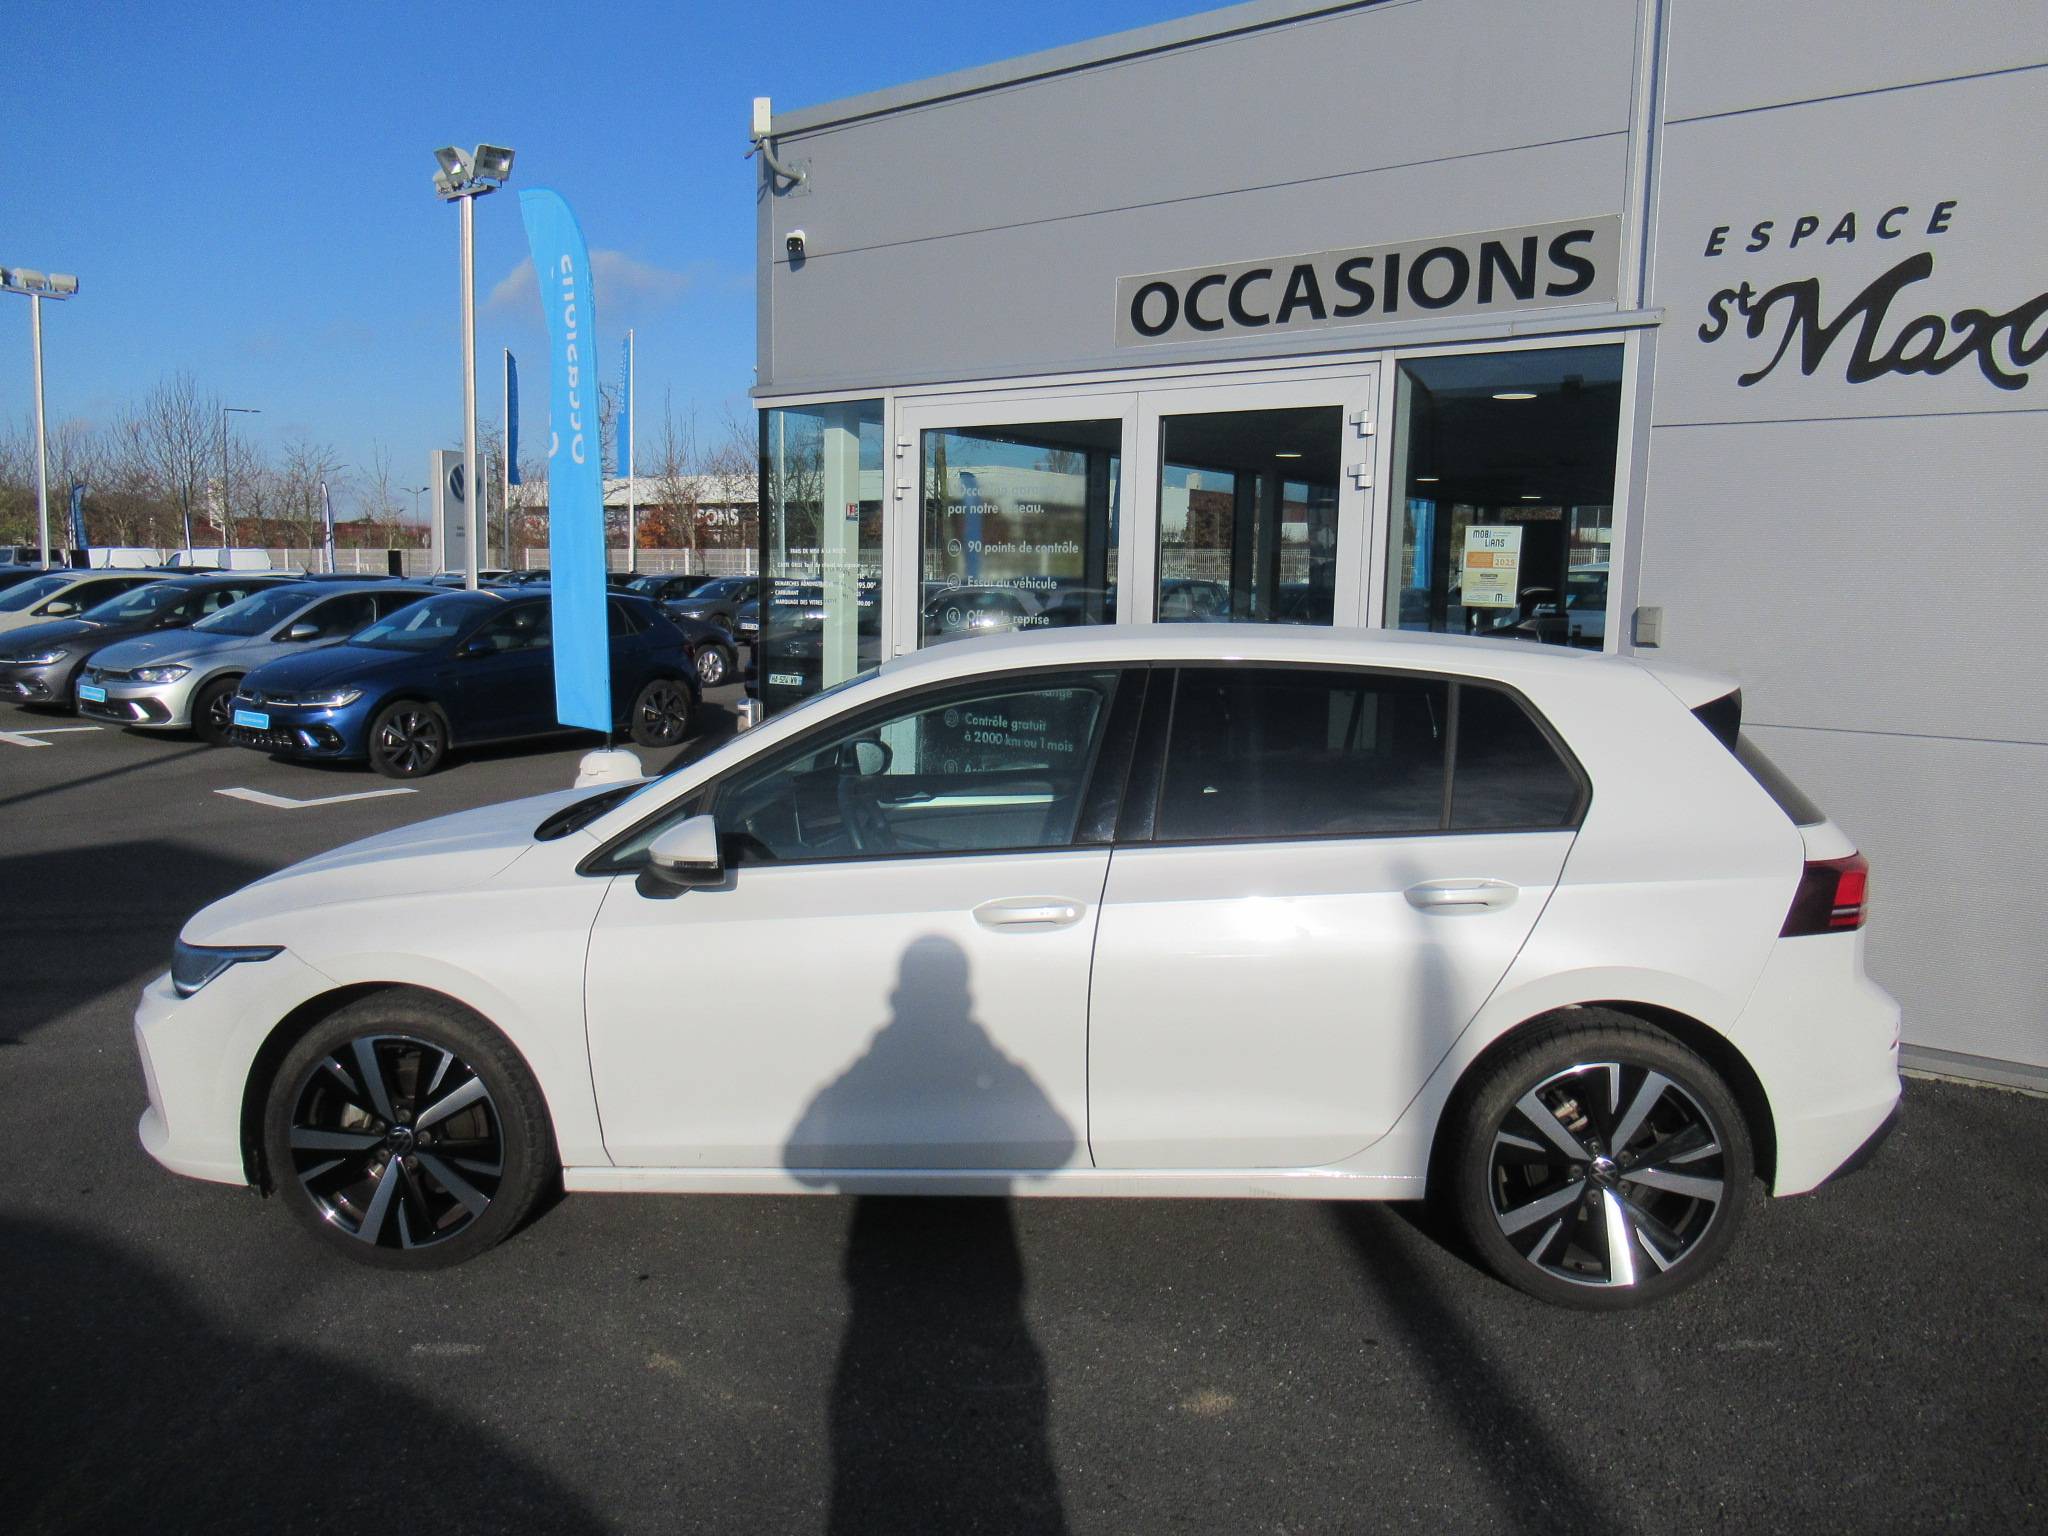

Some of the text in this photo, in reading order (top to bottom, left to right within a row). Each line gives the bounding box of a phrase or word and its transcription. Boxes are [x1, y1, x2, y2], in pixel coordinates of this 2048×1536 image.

[1704, 201, 1957, 257] ESPACE
[1130, 230, 1595, 337] OCCASIONS
[947, 504, 967, 518] par
[970, 502, 999, 514] notre
[967, 540, 1079, 555] 90 points de contrôle
[1013, 576, 1058, 590] véhicule
[1012, 612, 1050, 627] reprise
[965, 713, 1047, 732] Contrôle gratuit
[965, 731, 971, 742] à
[974, 731, 1003, 744] 2000
[1005, 734, 1021, 746] km
[1023, 739, 1037, 748] ou
[1047, 740, 1073, 752] mois
